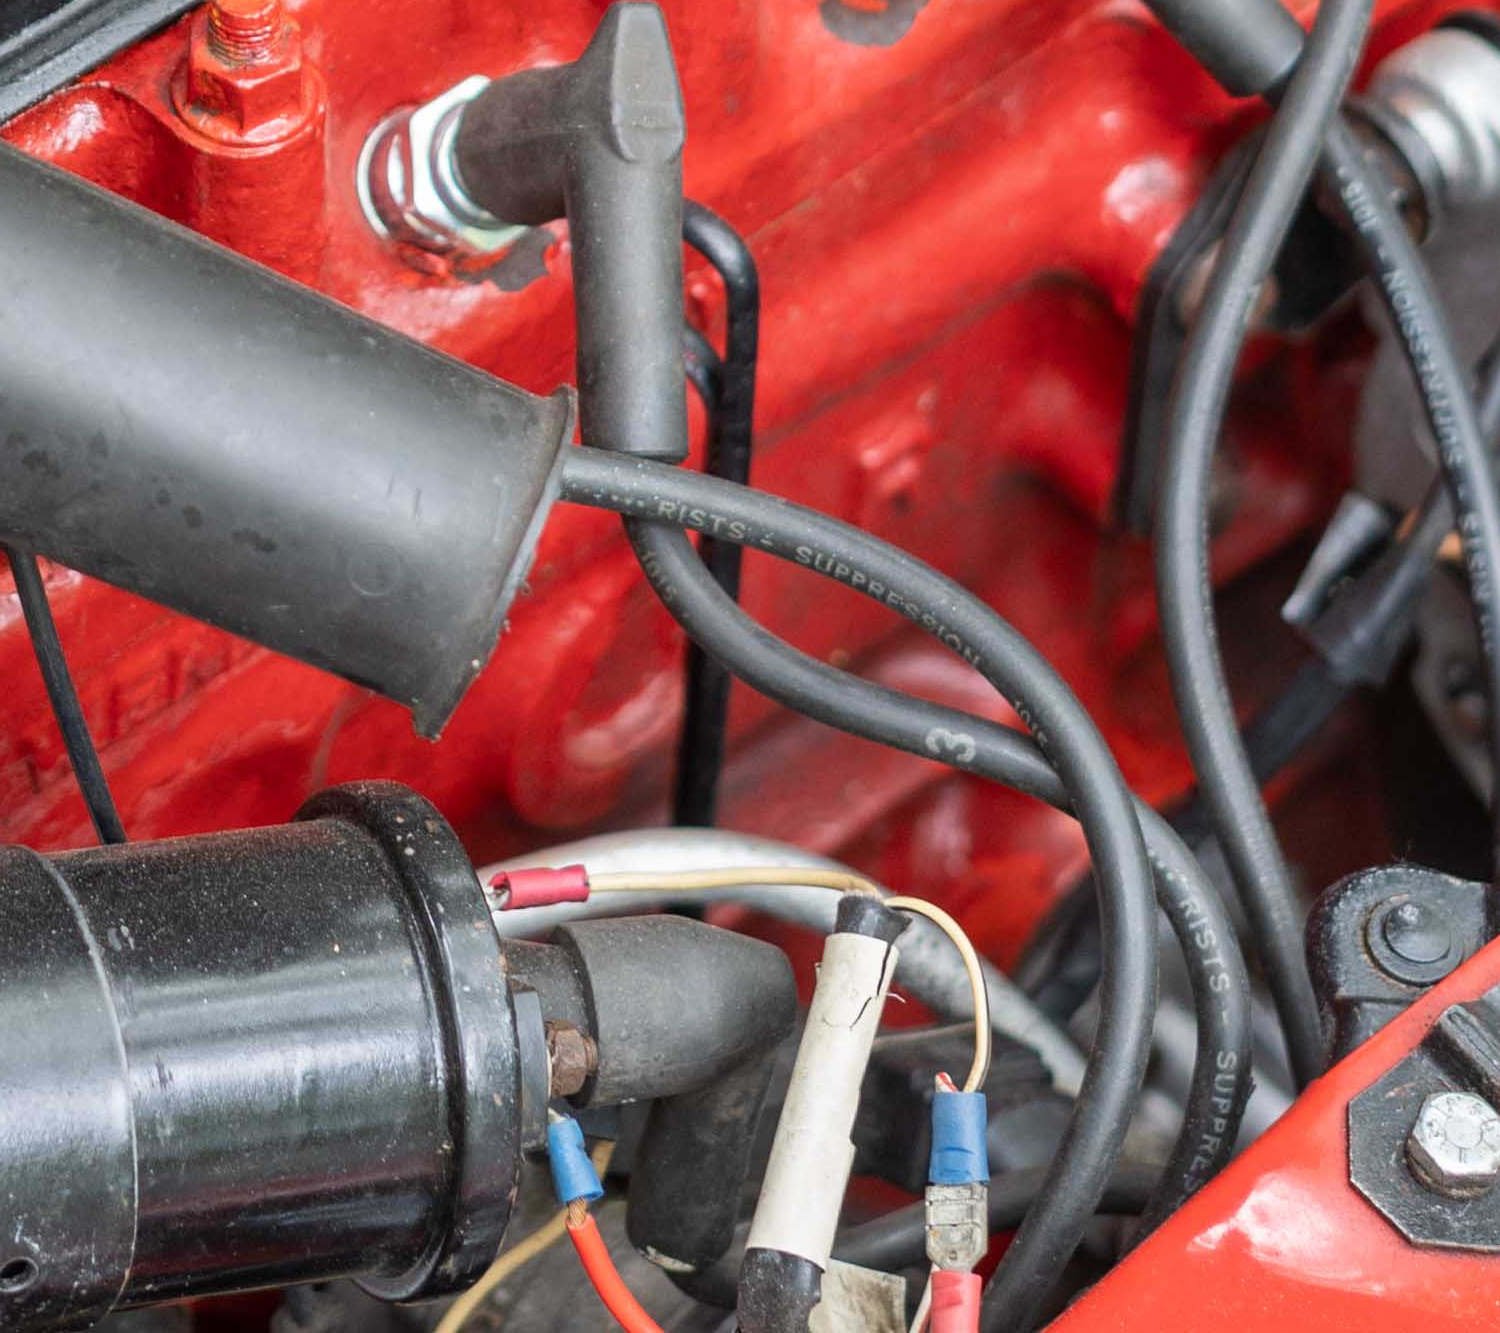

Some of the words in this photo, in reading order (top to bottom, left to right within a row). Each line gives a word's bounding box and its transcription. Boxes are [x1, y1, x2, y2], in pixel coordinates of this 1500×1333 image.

[656, 499, 747, 540] RISTS
[795, 546, 986, 667] SUPPRESSION
[924, 727, 977, 763] 3
[1179, 898, 1231, 993] RISTS
